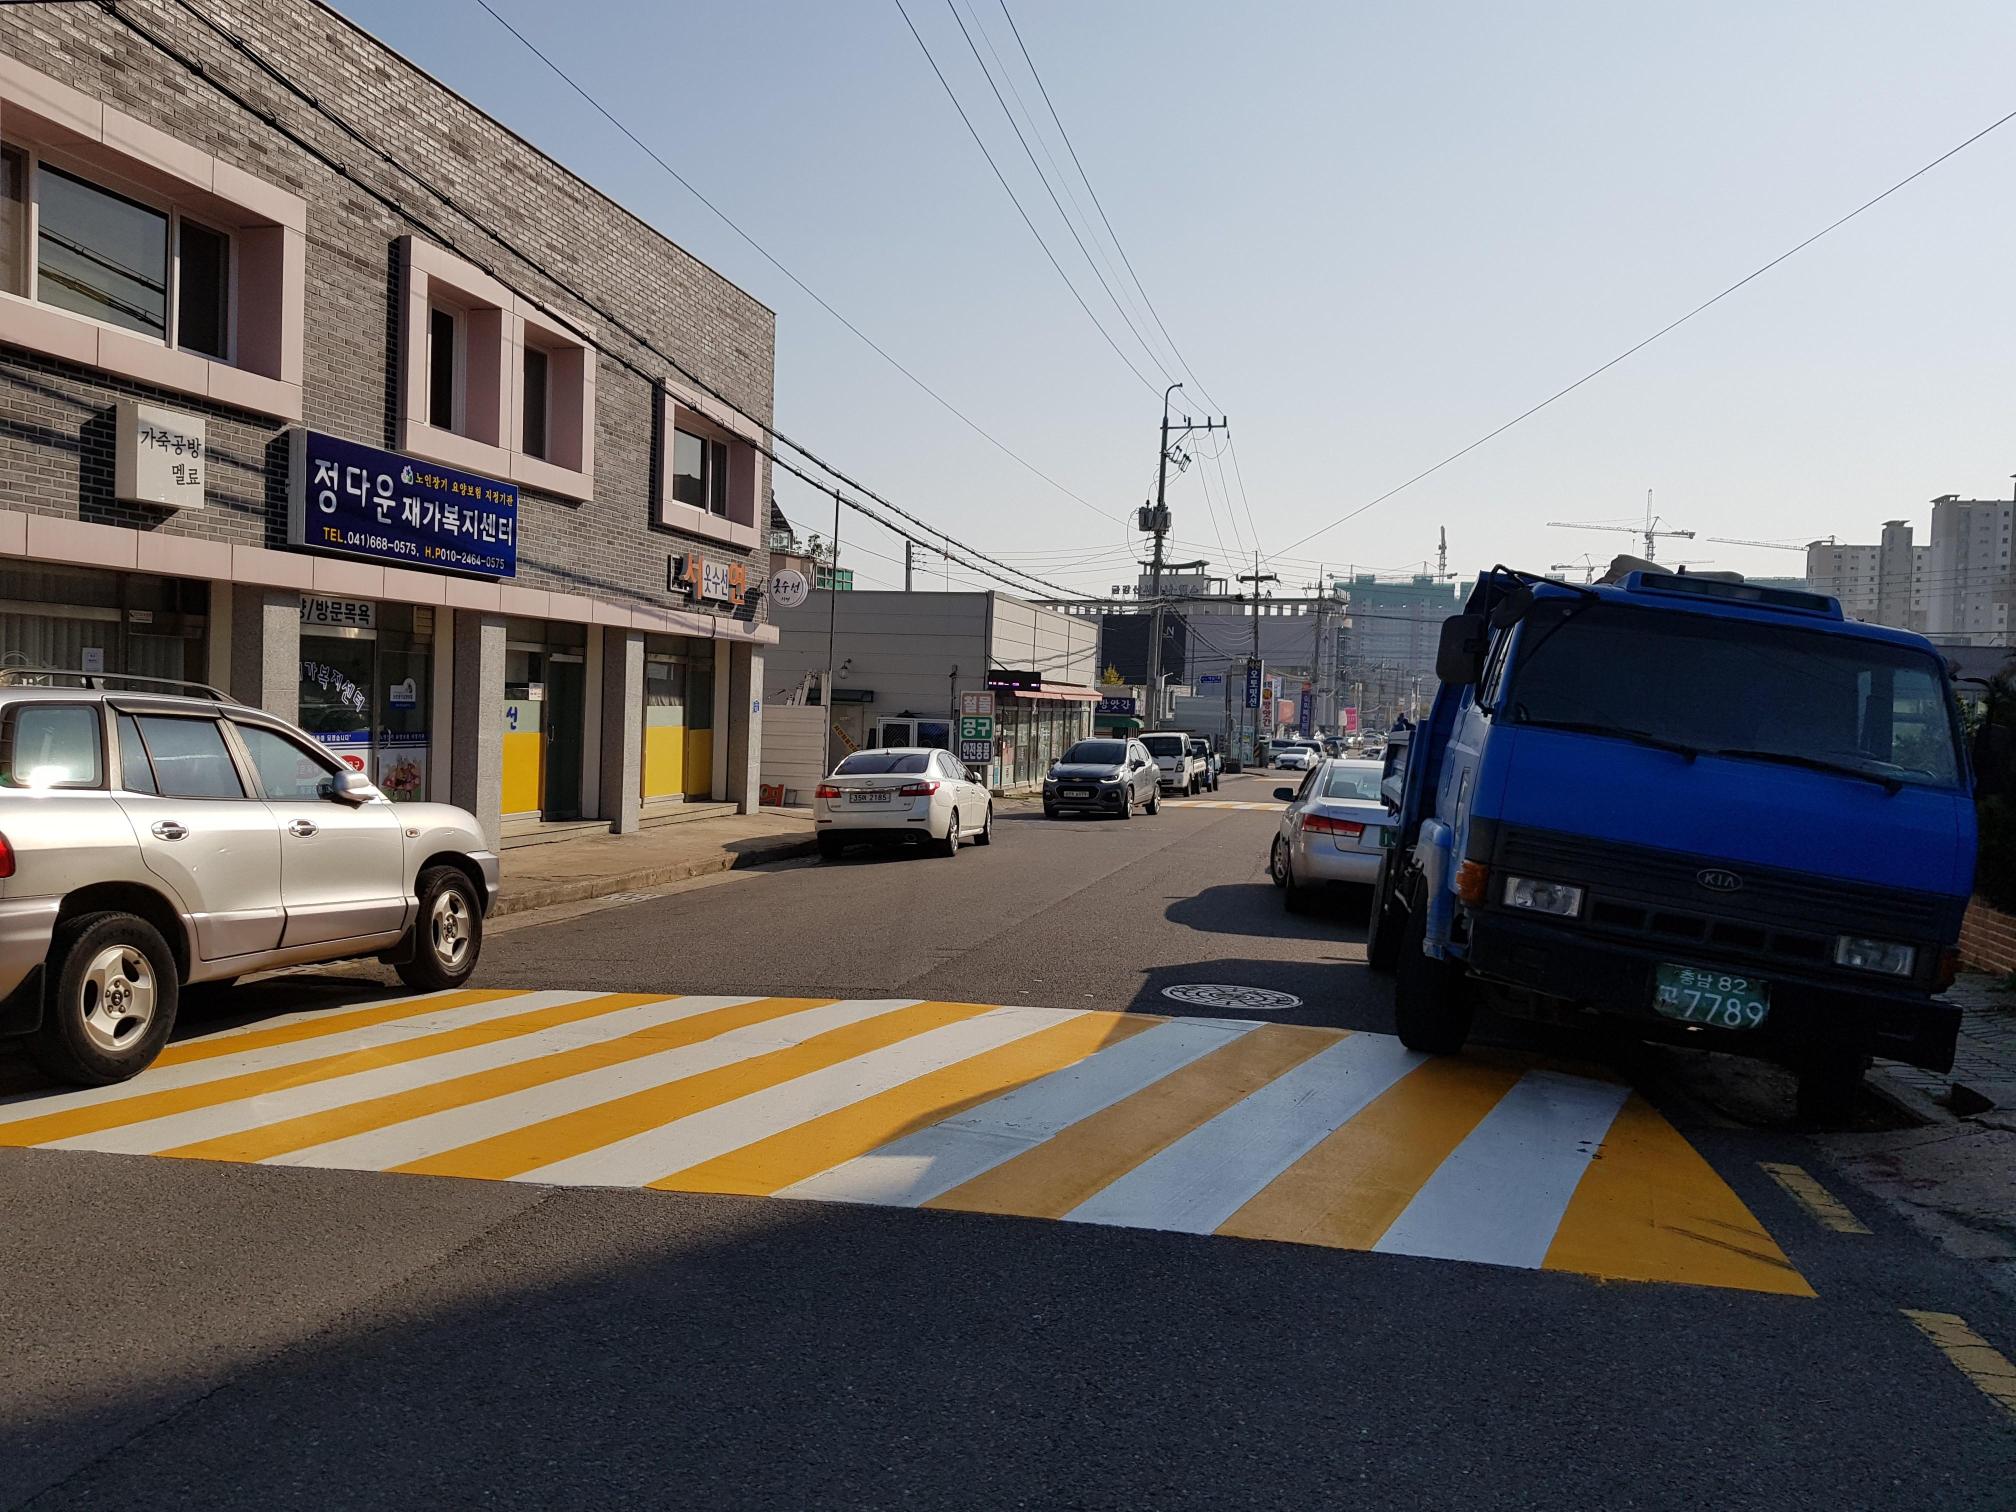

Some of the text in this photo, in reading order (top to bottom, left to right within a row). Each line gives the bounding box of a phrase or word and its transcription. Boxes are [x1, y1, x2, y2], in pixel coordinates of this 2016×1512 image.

[140, 427, 201, 459] 가죽공방
[172, 463, 201, 486] 멜료
[314, 458, 513, 546] 정다운 재가복지센터
[415, 472, 514, 508] 노인장기 요양보험 지정기관
[704, 564, 728, 596] 옷수선
[773, 578, 801, 594] 옷수선
[299, 662, 366, 713] 가복지센터
[963, 718, 991, 737] 공구
[1704, 872, 1735, 888] KIA
[1680, 969, 1747, 995] 충남 82
